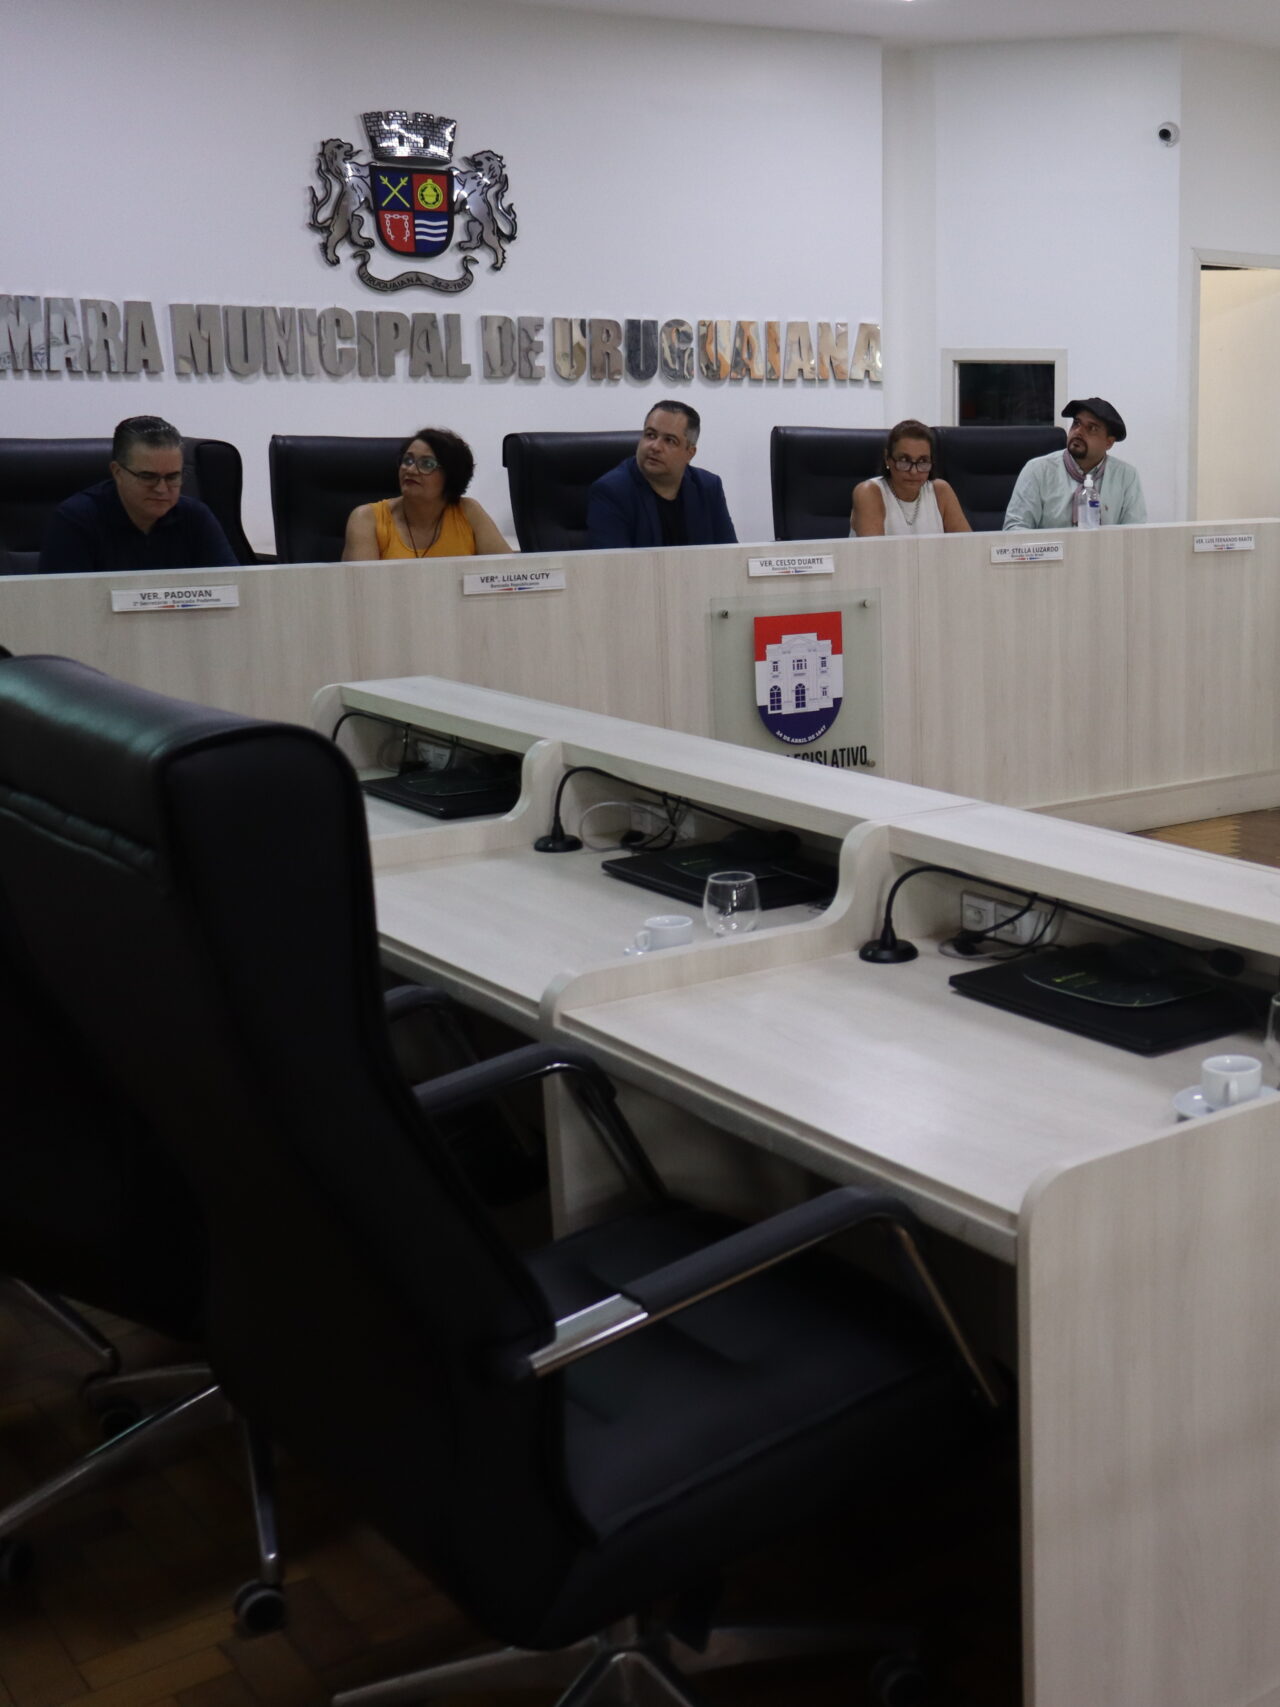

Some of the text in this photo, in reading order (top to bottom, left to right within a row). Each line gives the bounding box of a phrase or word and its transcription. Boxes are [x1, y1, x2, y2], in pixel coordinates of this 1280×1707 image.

[361, 271, 421, 290] URUGUAIANA
[169, 303, 471, 378] MUNICIPAL
[480, 315, 545, 379] DE
[552, 318, 883, 383] URUGUAIANA
[1011, 547, 1031, 555] STELLA
[1032, 546, 1059, 554] LUZARDO
[776, 559, 796, 567] CELSO
[797, 557, 823, 565] DUARTE
[502, 573, 528, 582] LILIAN
[529, 572, 550, 580] CUTY
[139, 590, 212, 601] VER. PADOVAN
